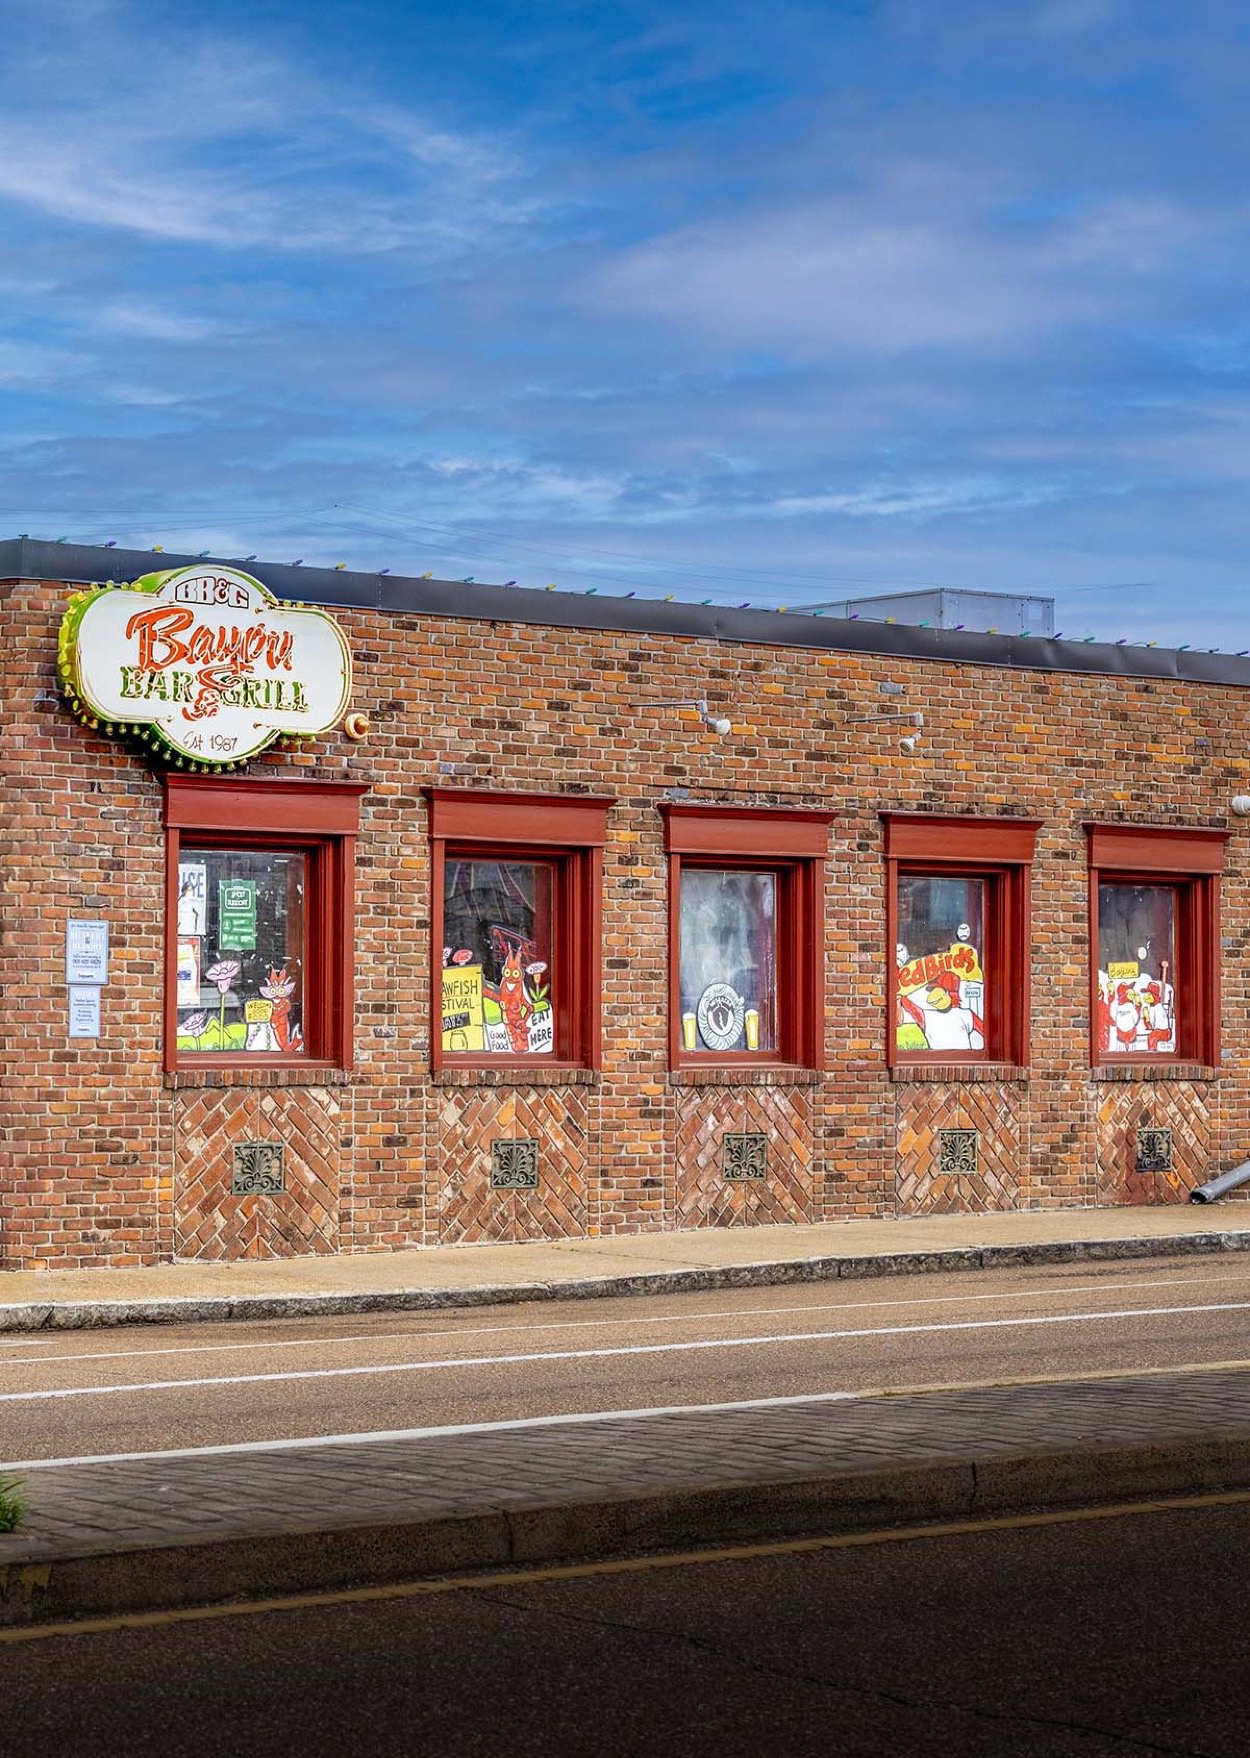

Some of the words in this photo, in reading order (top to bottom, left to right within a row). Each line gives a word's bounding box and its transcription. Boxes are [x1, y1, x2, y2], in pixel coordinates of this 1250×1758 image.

[175, 576, 250, 609] BB&G
[126, 605, 295, 676] Bayou
[119, 666, 194, 703] BAR
[220, 676, 310, 713] GRILL
[209, 734, 238, 752] 1987
[530, 1027, 552, 1047] HERE
